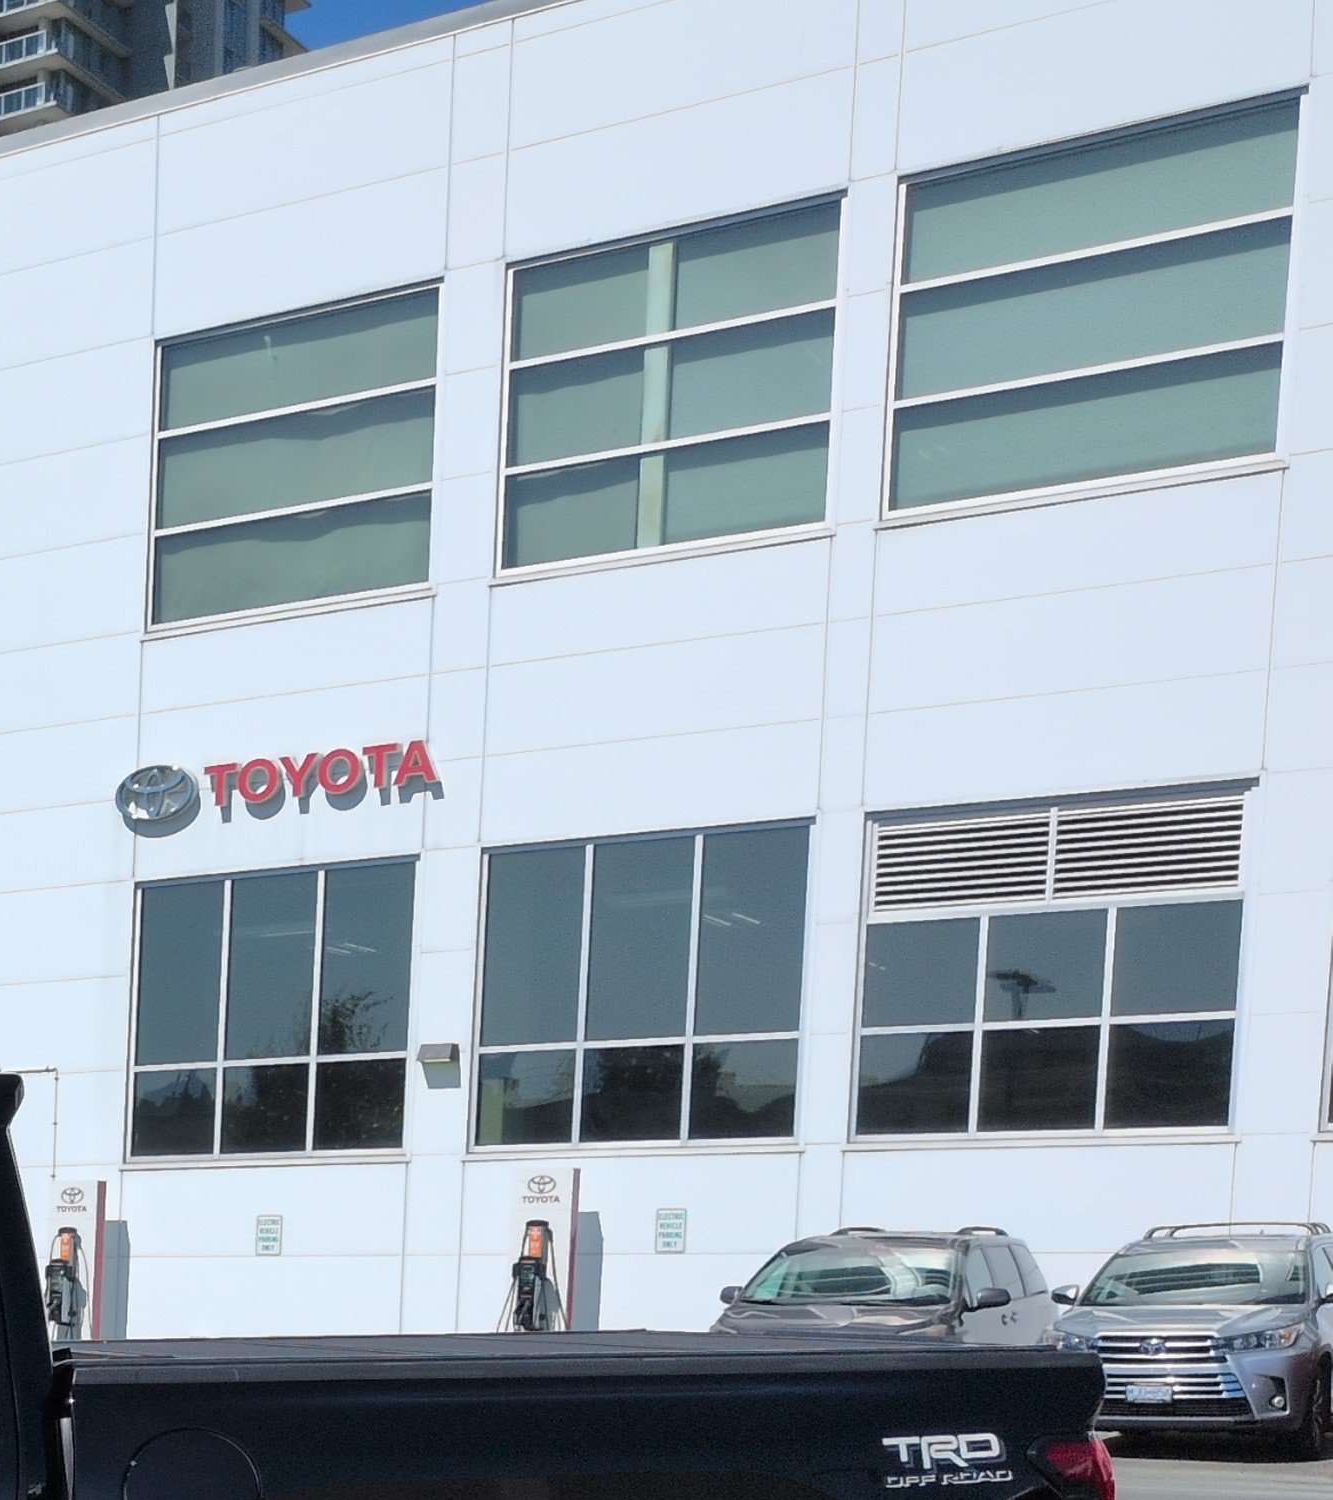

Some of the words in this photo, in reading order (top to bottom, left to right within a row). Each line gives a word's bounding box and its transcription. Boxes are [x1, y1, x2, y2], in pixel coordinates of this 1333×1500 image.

[204, 740, 439, 807] TOYOTA
[56, 1205, 87, 1213] TOYOTA
[522, 1195, 560, 1204] TOYOTA
[882, 1432, 1001, 1469] TRD
[886, 1475, 936, 1488] OFF
[941, 1469, 1014, 1486] ROAD
